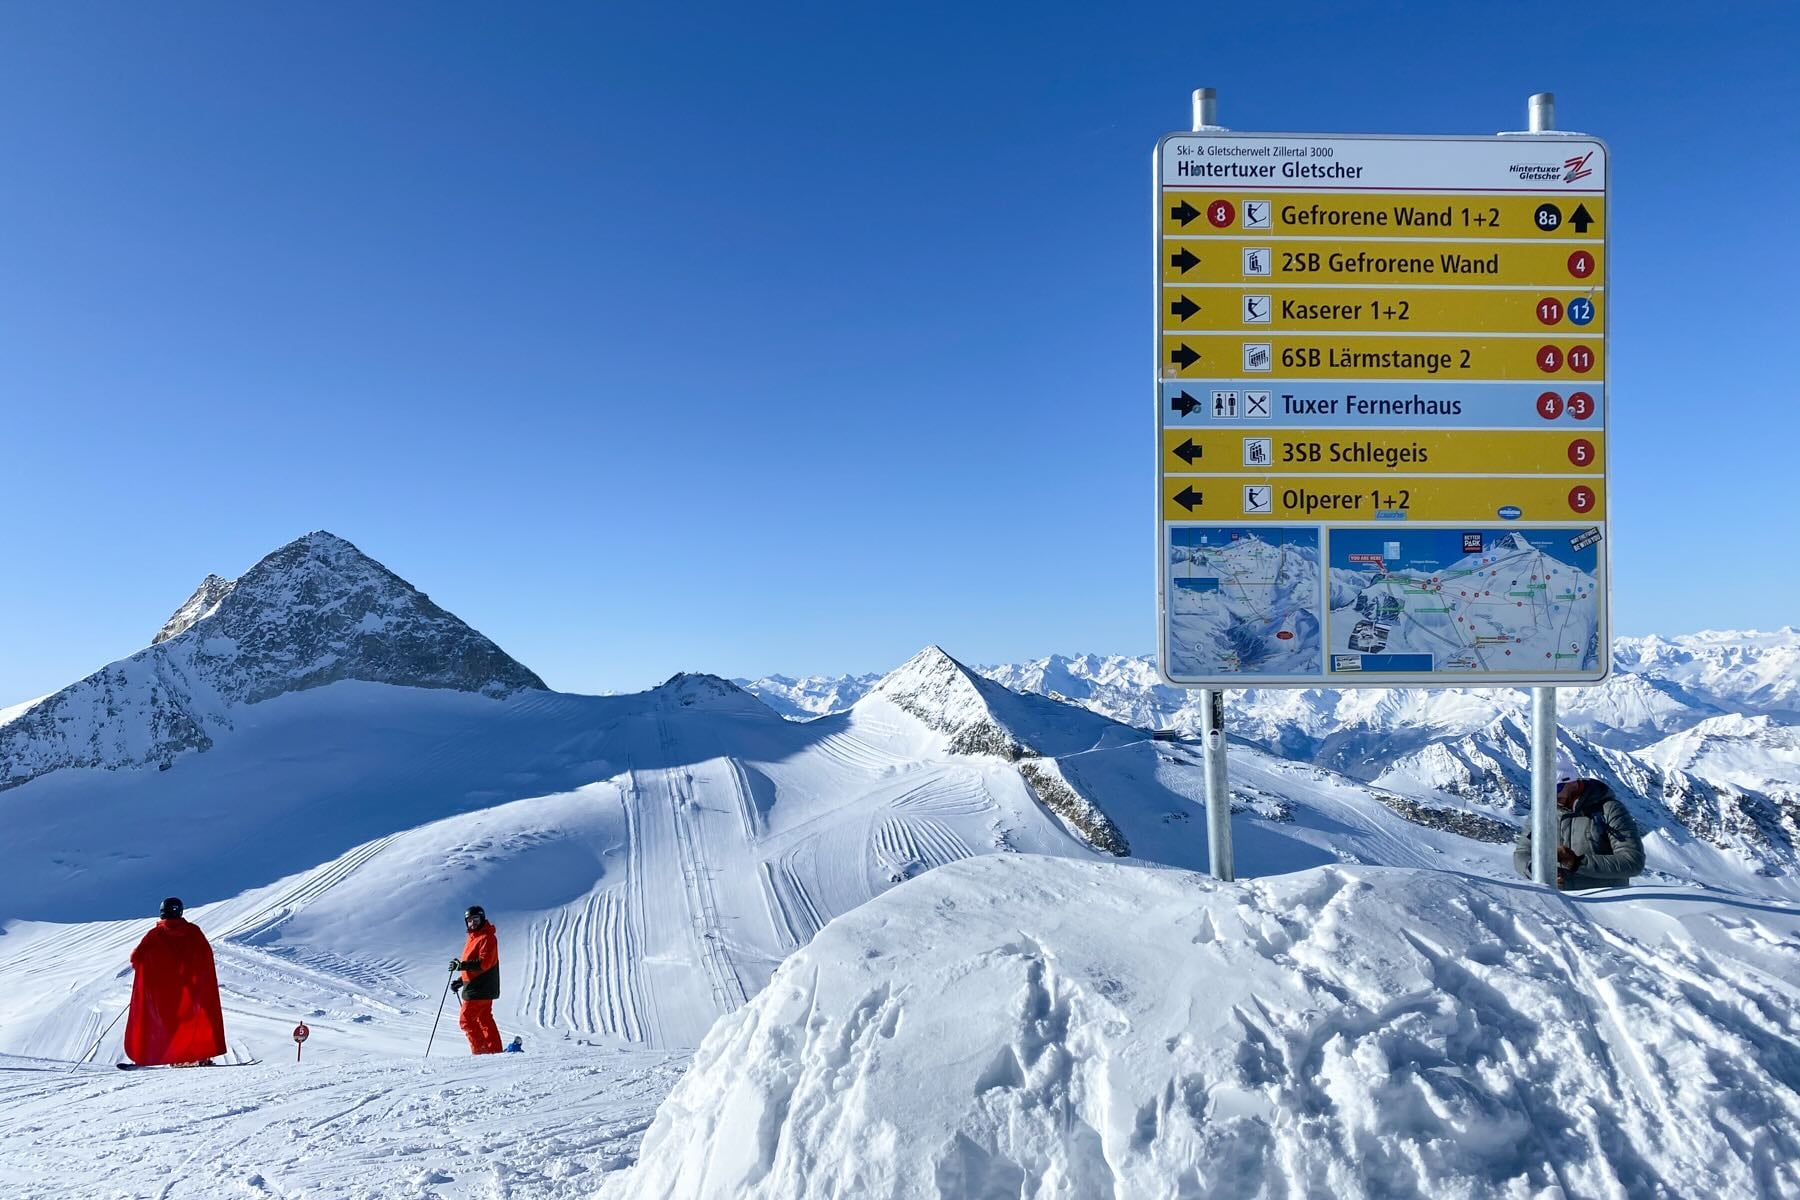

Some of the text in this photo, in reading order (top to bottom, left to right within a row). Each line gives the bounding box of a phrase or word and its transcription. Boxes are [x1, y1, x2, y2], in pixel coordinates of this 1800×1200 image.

[1176, 145, 1334, 157] Ski- & Gletscherwelt Zillertal 3000
[1178, 160, 1363, 178] Hintertuxer Gletscher
[1509, 164, 1561, 173] Hintertuxer
[1519, 172, 1561, 180] Gletscher
[1215, 206, 1226, 222] 8
[1281, 206, 1500, 227] Gefrorene Wand 1+2
[1538, 210, 1557, 225] 8a
[1282, 252, 1498, 274] 2SB Gefrorene Wand
[1576, 257, 1586, 273] 4
[1282, 301, 1410, 320] Kaserer 1+2
[1541, 304, 1591, 320] 11 12
[1281, 348, 1471, 373] 6SB Lärmstange 2
[1544, 352, 1588, 367] 4 11
[1281, 395, 1462, 415] Tuxer Fernerhaus
[1545, 399, 1585, 414] 4 3
[1282, 442, 1428, 466] 3SB Schlegeis
[1577, 446, 1586, 461] 5
[1282, 489, 1410, 513] Olperer 1+2
[1577, 492, 1586, 507] 5
